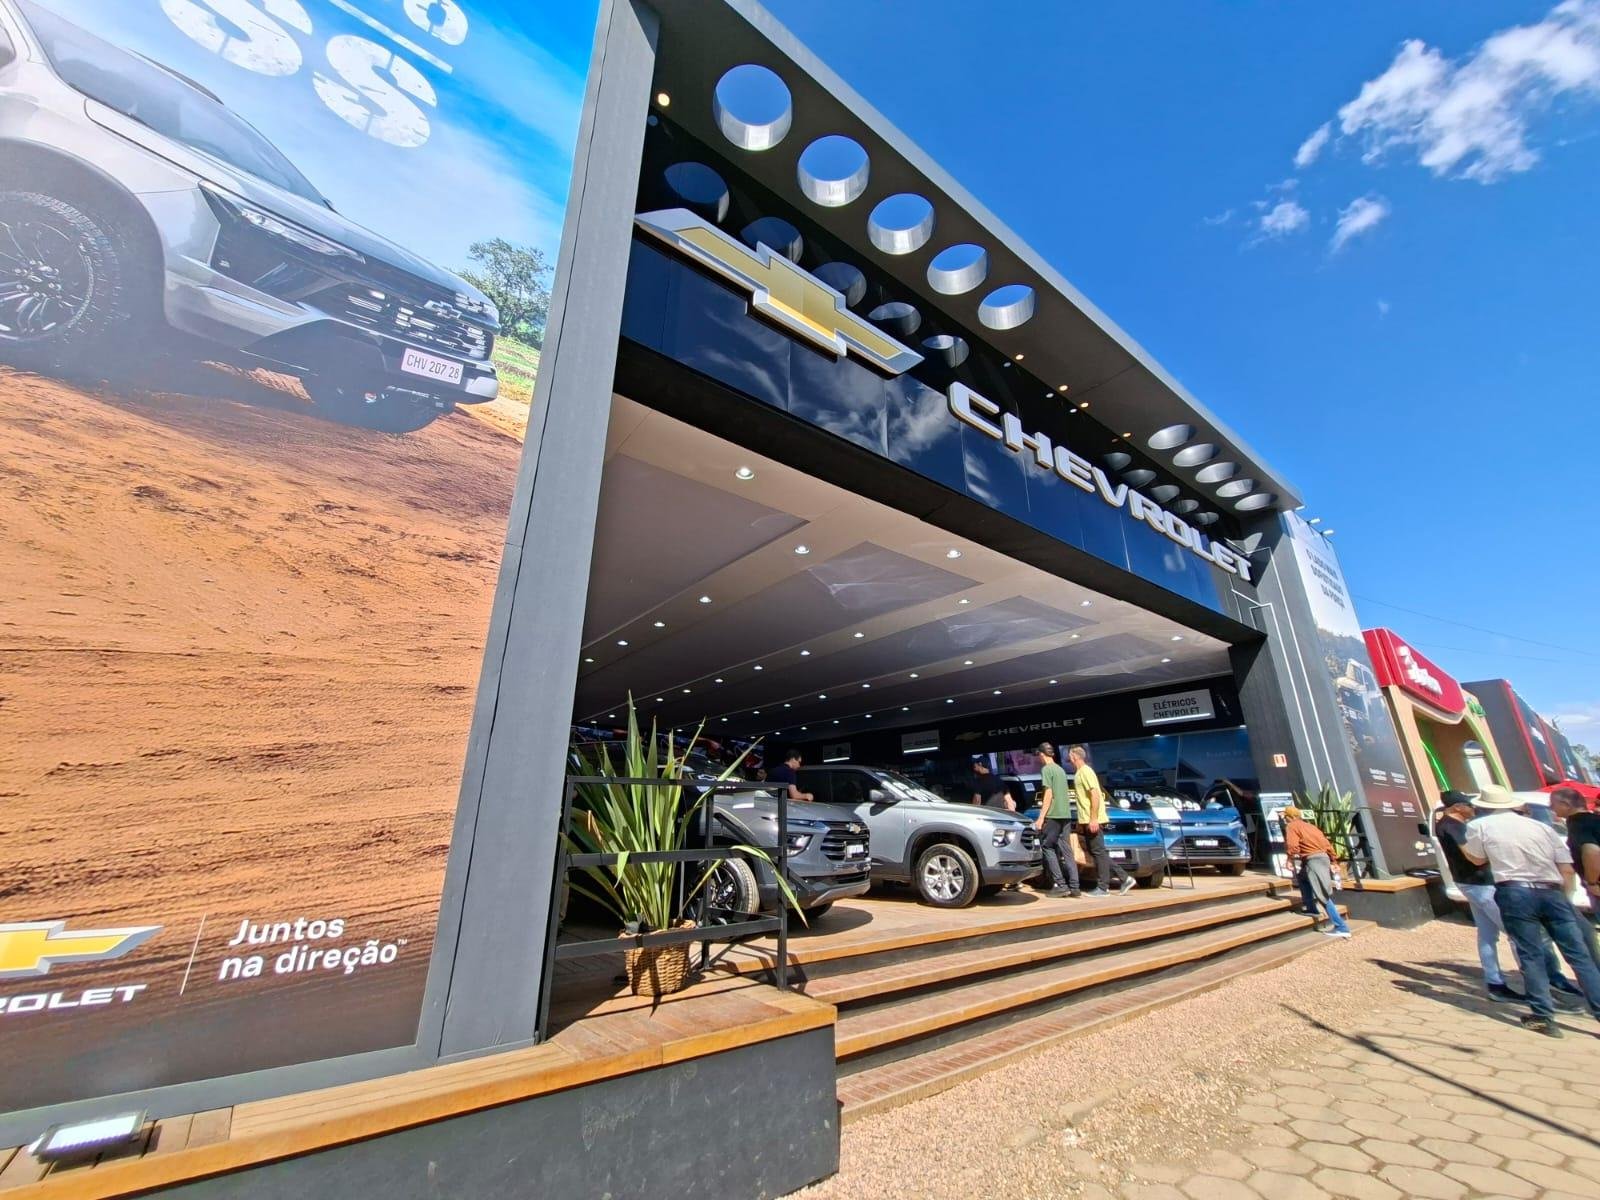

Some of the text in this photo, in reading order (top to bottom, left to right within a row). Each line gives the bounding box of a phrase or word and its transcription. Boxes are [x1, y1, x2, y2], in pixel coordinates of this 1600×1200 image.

[406, 354, 460, 380] CHV 207 28
[948, 381, 1252, 581] CHEVROLET
[1153, 697, 1197, 711] ELÉTRICOS
[1153, 707, 1201, 720] CHEVROLET
[987, 717, 1086, 737] CHEVROLET
[228, 916, 346, 947] Juntos
[217, 954, 265, 981] na
